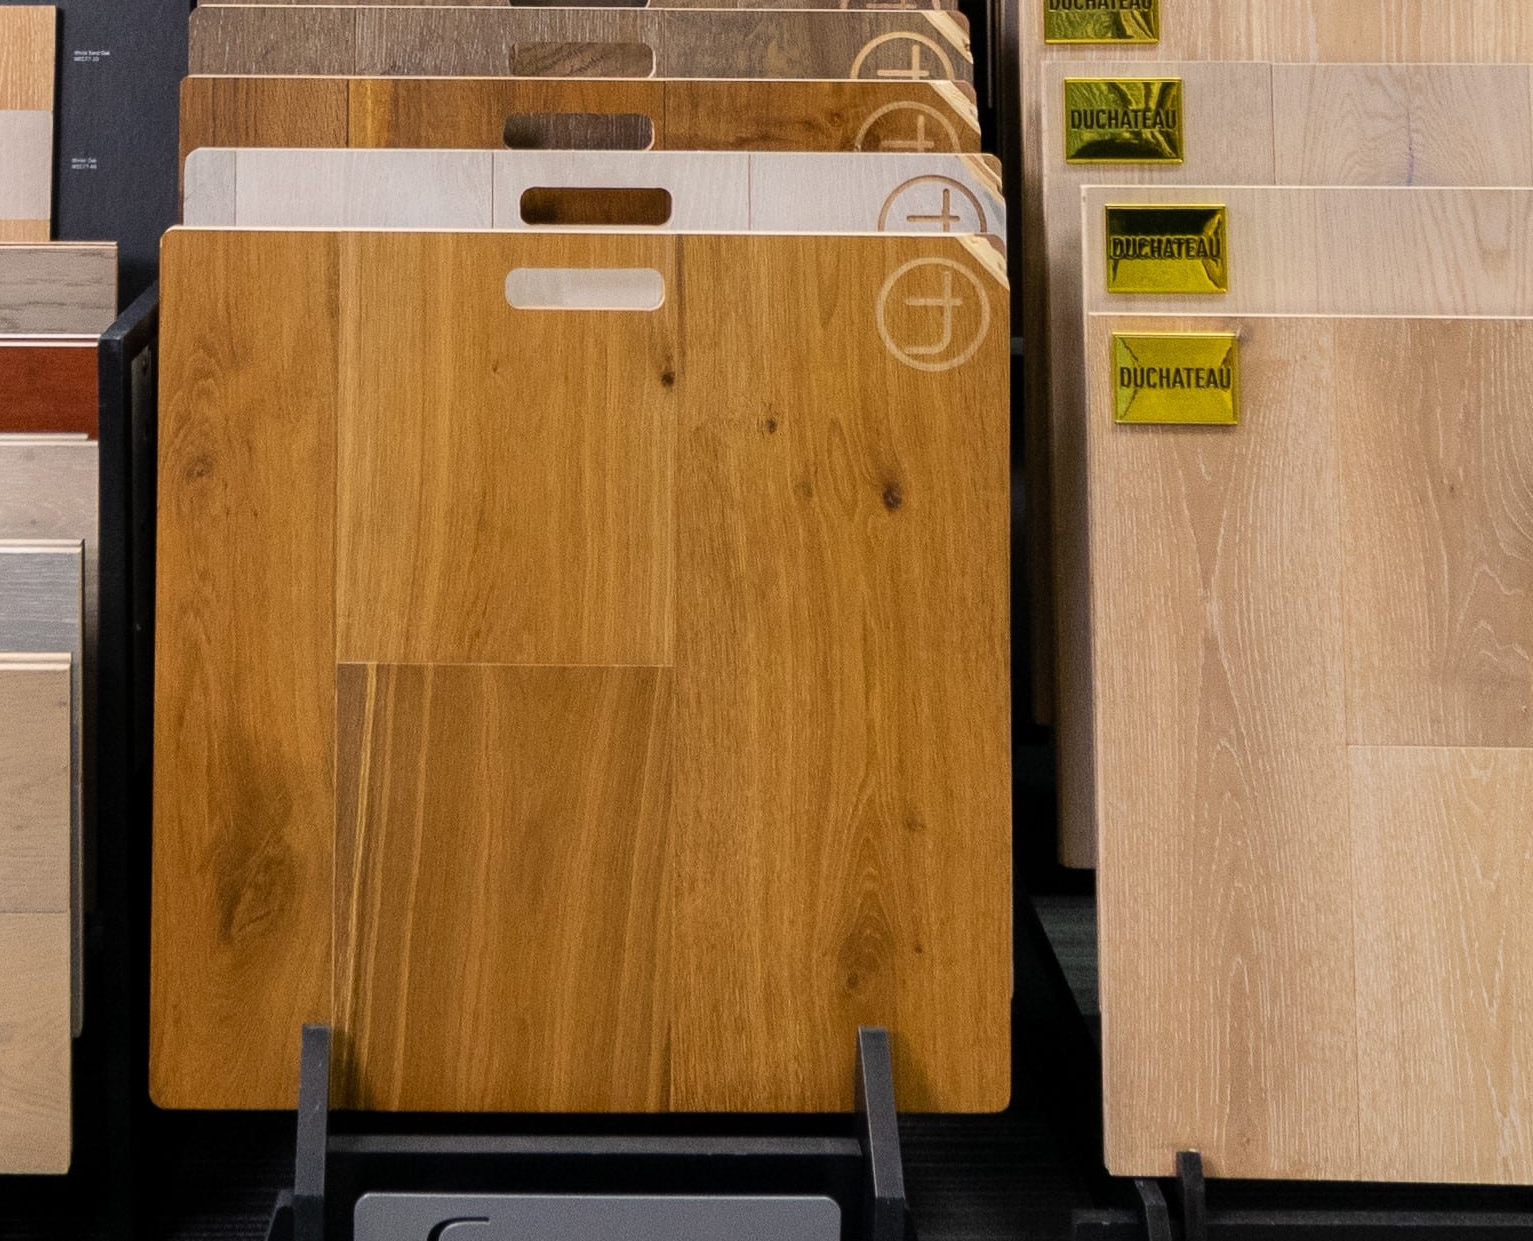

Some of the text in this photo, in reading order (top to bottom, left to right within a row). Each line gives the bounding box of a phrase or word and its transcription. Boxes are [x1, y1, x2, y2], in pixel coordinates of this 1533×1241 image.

[1070, 109, 1177, 130] DUCHATEAU
[1111, 237, 1222, 260] DUCHATEAU
[1119, 366, 1231, 389] DUCHATEAU
